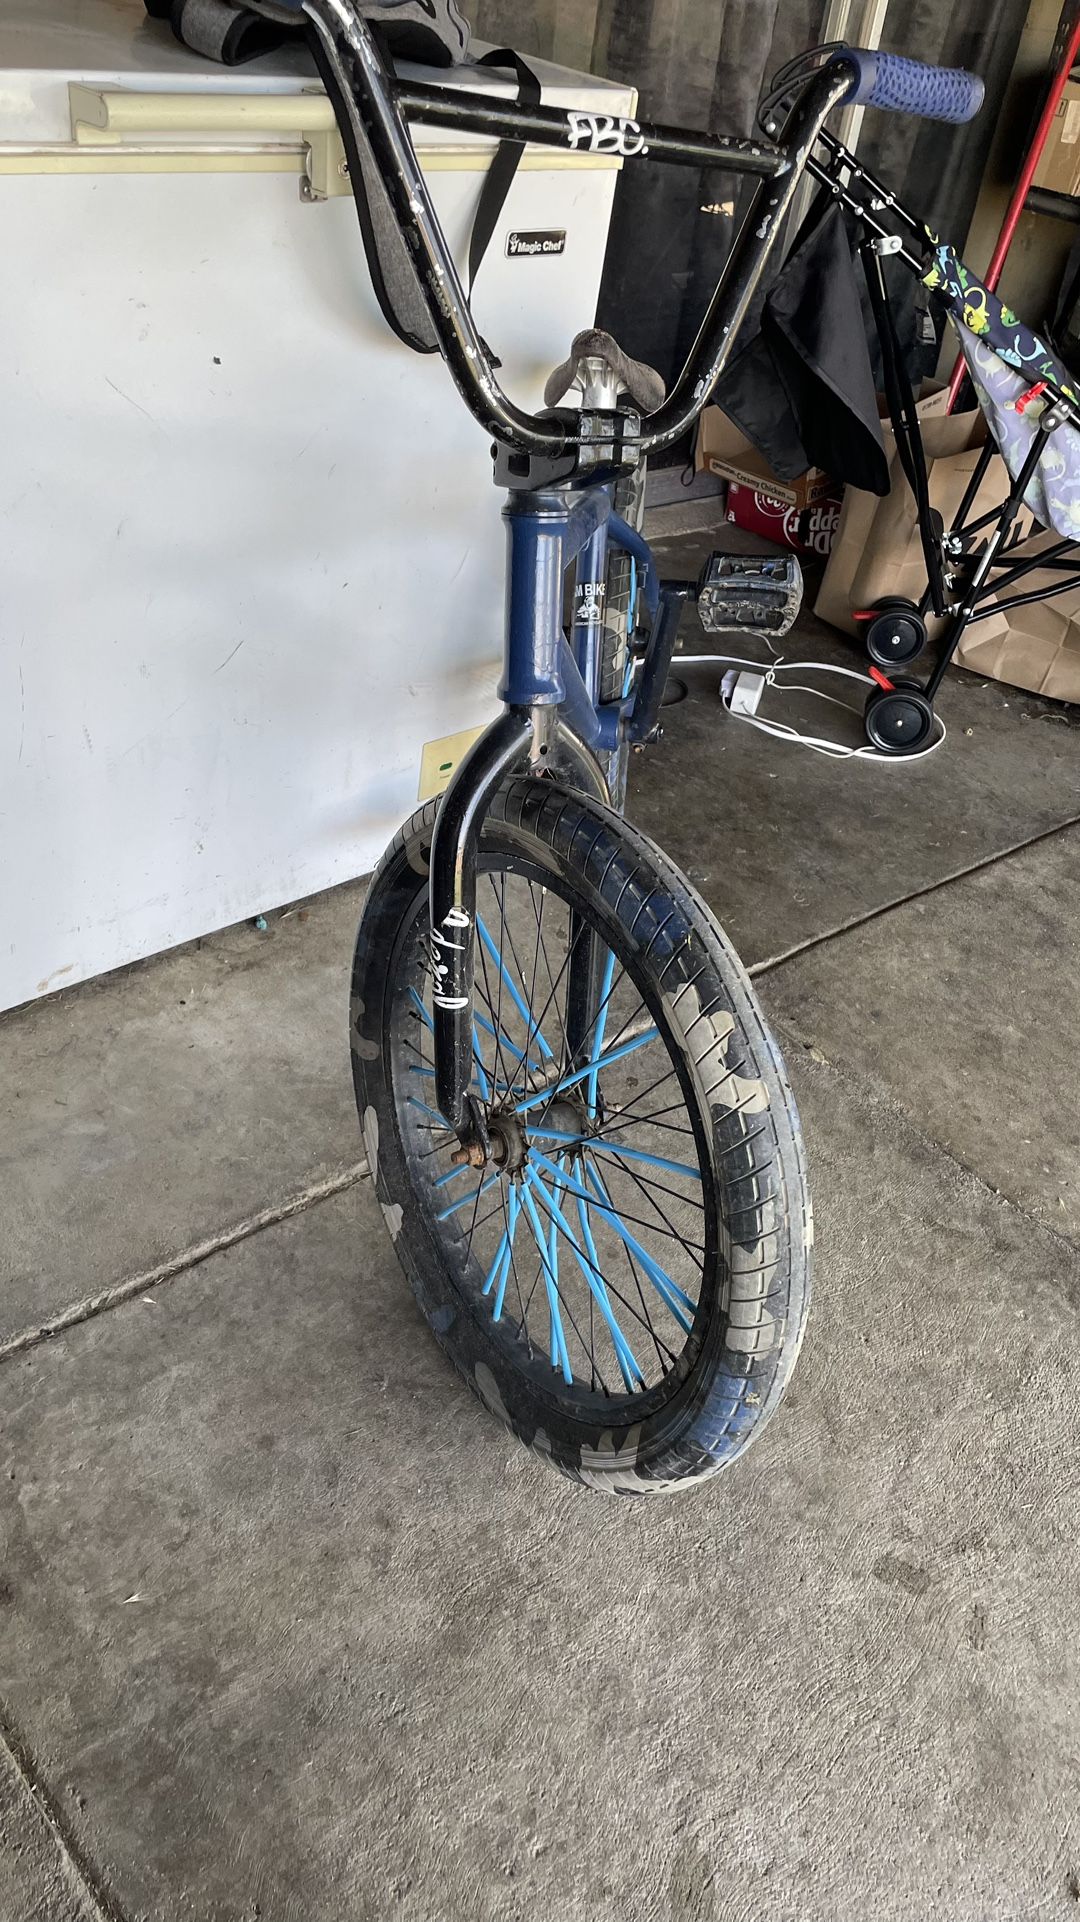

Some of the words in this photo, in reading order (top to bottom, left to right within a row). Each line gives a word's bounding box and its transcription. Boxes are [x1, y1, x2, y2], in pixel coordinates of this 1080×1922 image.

[518, 241, 542, 254] Magic
[543, 240, 561, 252] Chef
[736, 472, 760, 489] Creamy
[761, 482, 786, 498] Chicken
[805, 531, 831, 555] Dr
